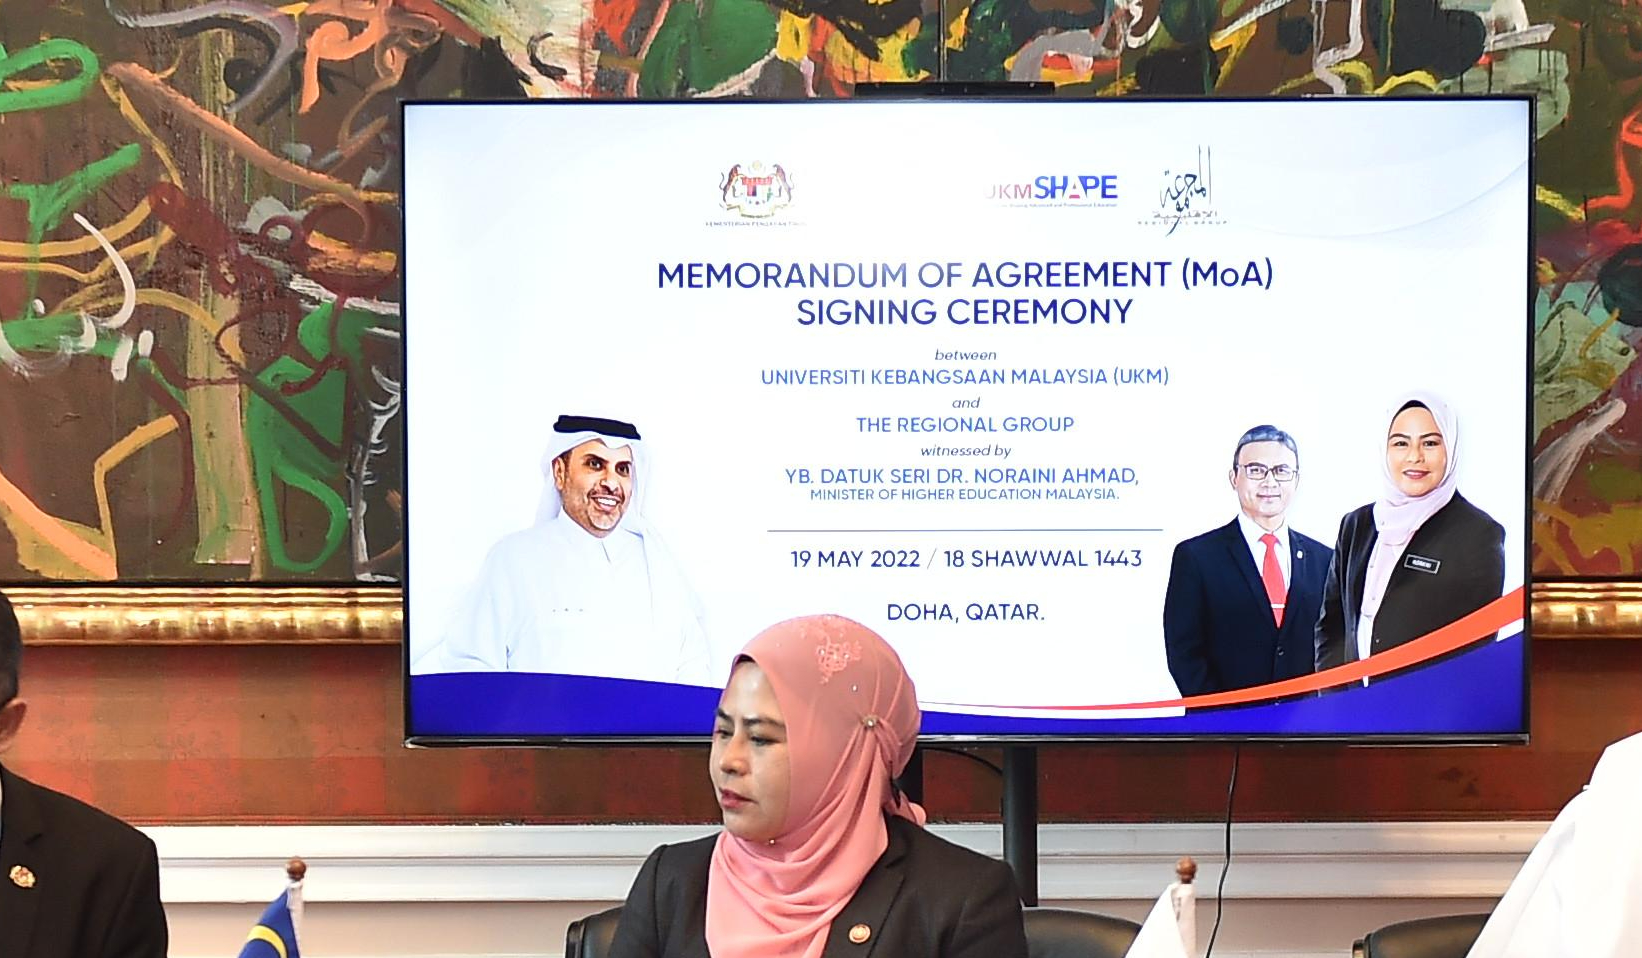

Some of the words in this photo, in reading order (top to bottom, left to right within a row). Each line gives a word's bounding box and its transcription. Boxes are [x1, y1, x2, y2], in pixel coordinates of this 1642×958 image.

[658, 262, 907, 289] MEMORANDUM
[917, 262, 963, 288] OF
[971, 261, 1173, 288] AGREEMENT
[1182, 256, 1273, 291] (MoA)
[796, 298, 938, 326] SIGNING
[946, 298, 1134, 326] CEREMONY
[934, 348, 997, 361] between
[761, 369, 865, 385] UNIVERSITI
[871, 369, 1005, 385] KEBANGSAAN
[1011, 368, 1108, 385] MALAYSIA
[1113, 366, 1170, 387] (UKM)
[951, 396, 981, 409] and
[855, 417, 892, 433] THE
[897, 417, 998, 433] REGIONAL
[1002, 416, 1075, 433] GROUP
[920, 444, 992, 457] witnessed
[994, 444, 1012, 460] by
[785, 468, 815, 484] YB.
[821, 468, 885, 484] DATUK
[890, 468, 931, 484] SERI
[937, 468, 969, 484] DR.
[974, 468, 1056, 484] NORAINI
[1061, 467, 1139, 487] AHMAD,
[810, 488, 875, 501] MINISTER
[878, 488, 898, 500] OF
[901, 488, 955, 501] HIGHER
[958, 488, 1042, 501] EDUCATION
[1045, 487, 1120, 500] MALAYSIA.
[790, 550, 812, 568] 19
[817, 550, 864, 568] MAY
[870, 550, 921, 568] 2022
[943, 550, 965, 568] 18
[970, 549, 1089, 568] SHAWWAL
[1094, 549, 1143, 568] 1443
[887, 603, 959, 625] DOHA,
[965, 602, 1046, 621] QATAR.
